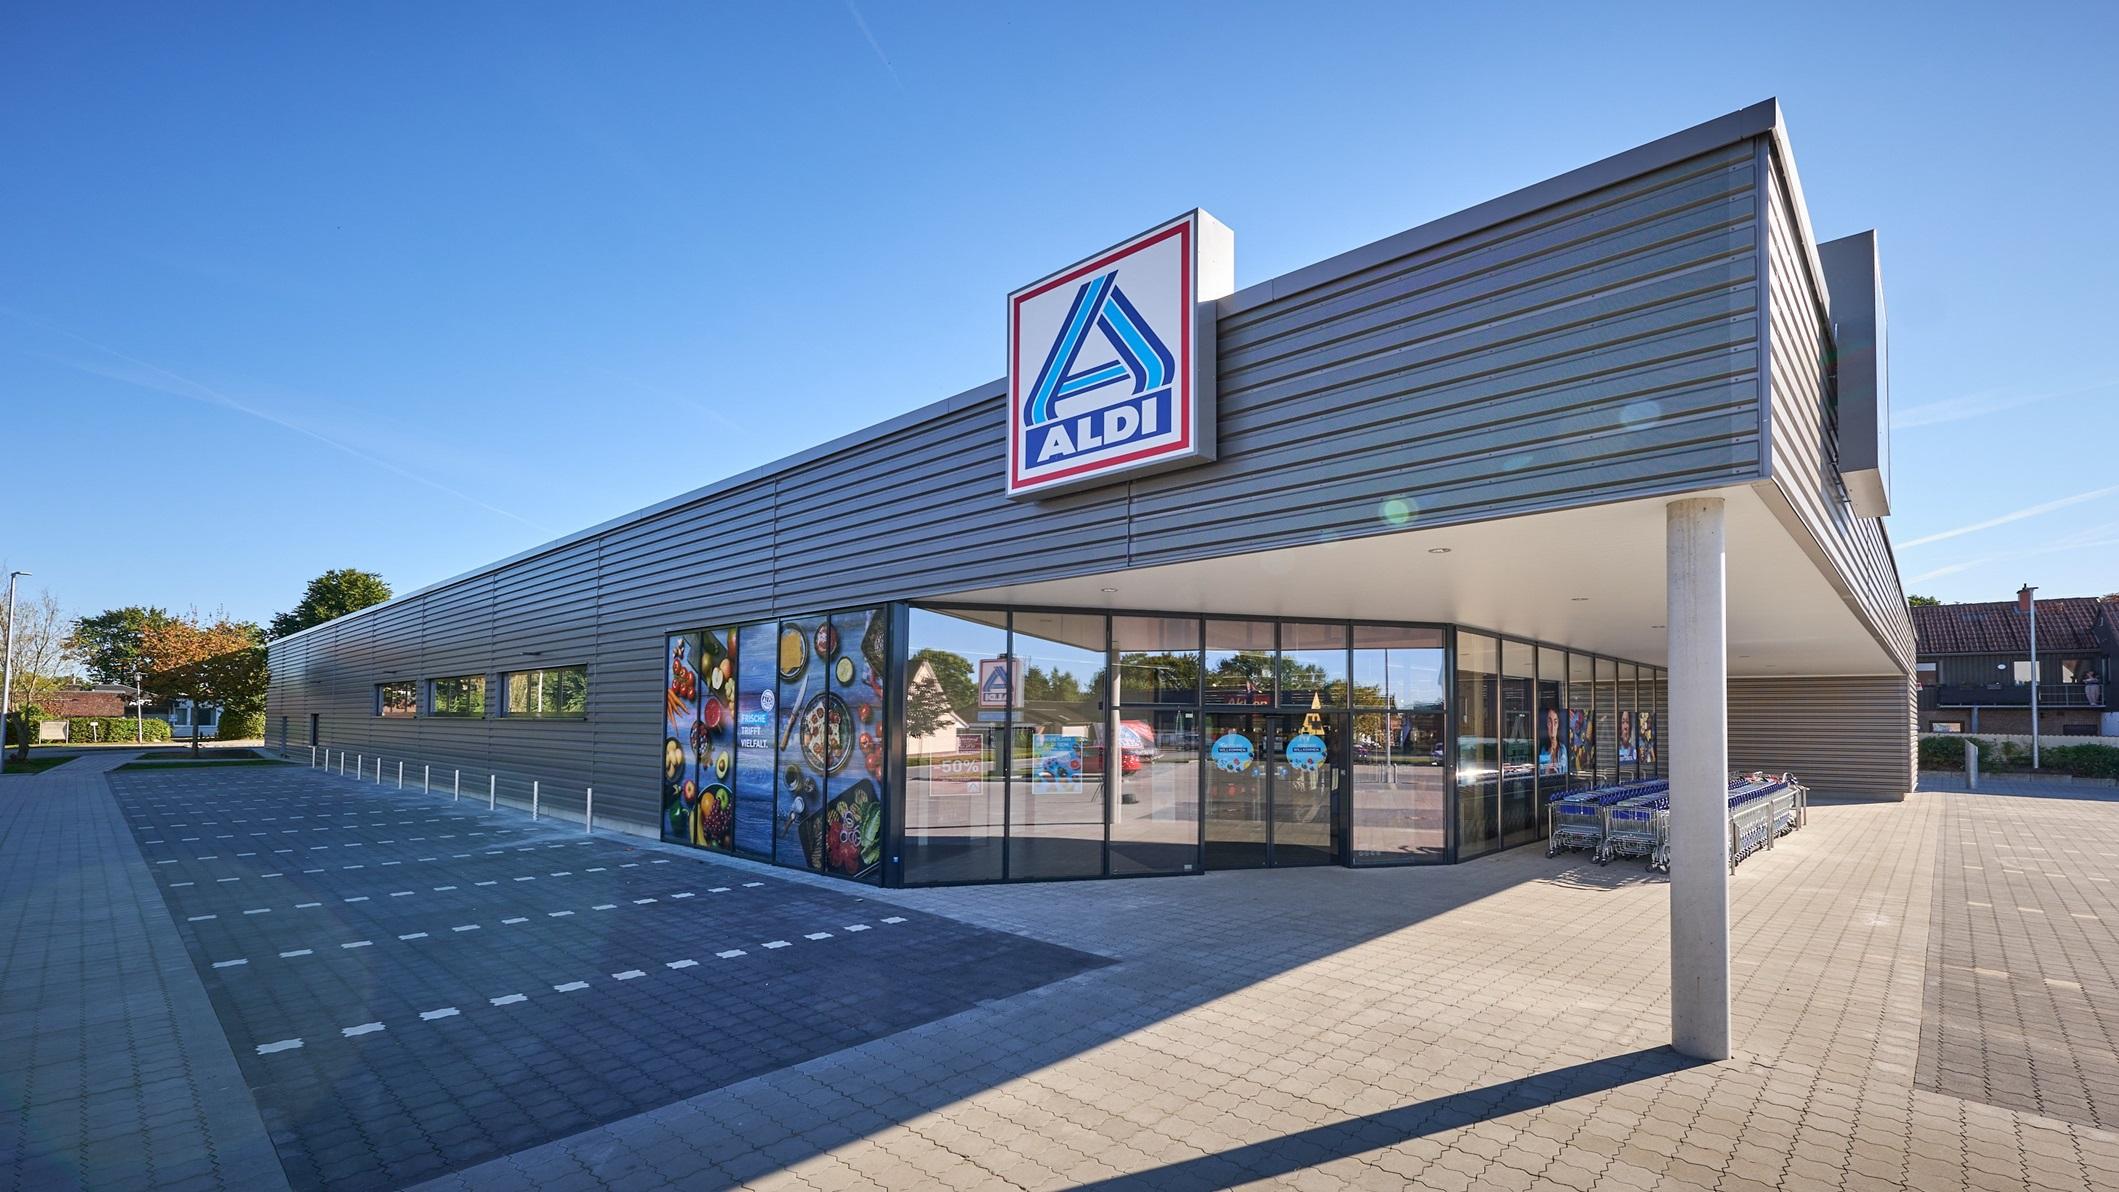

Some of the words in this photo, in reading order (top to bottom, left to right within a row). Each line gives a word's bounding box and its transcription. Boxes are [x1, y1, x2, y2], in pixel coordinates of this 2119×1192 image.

[1037, 396, 1157, 463] ALDI
[741, 713, 766, 723] FRISCHE
[741, 726, 761, 736] TRIFFT
[740, 738, 768, 749] VIELFALT.
